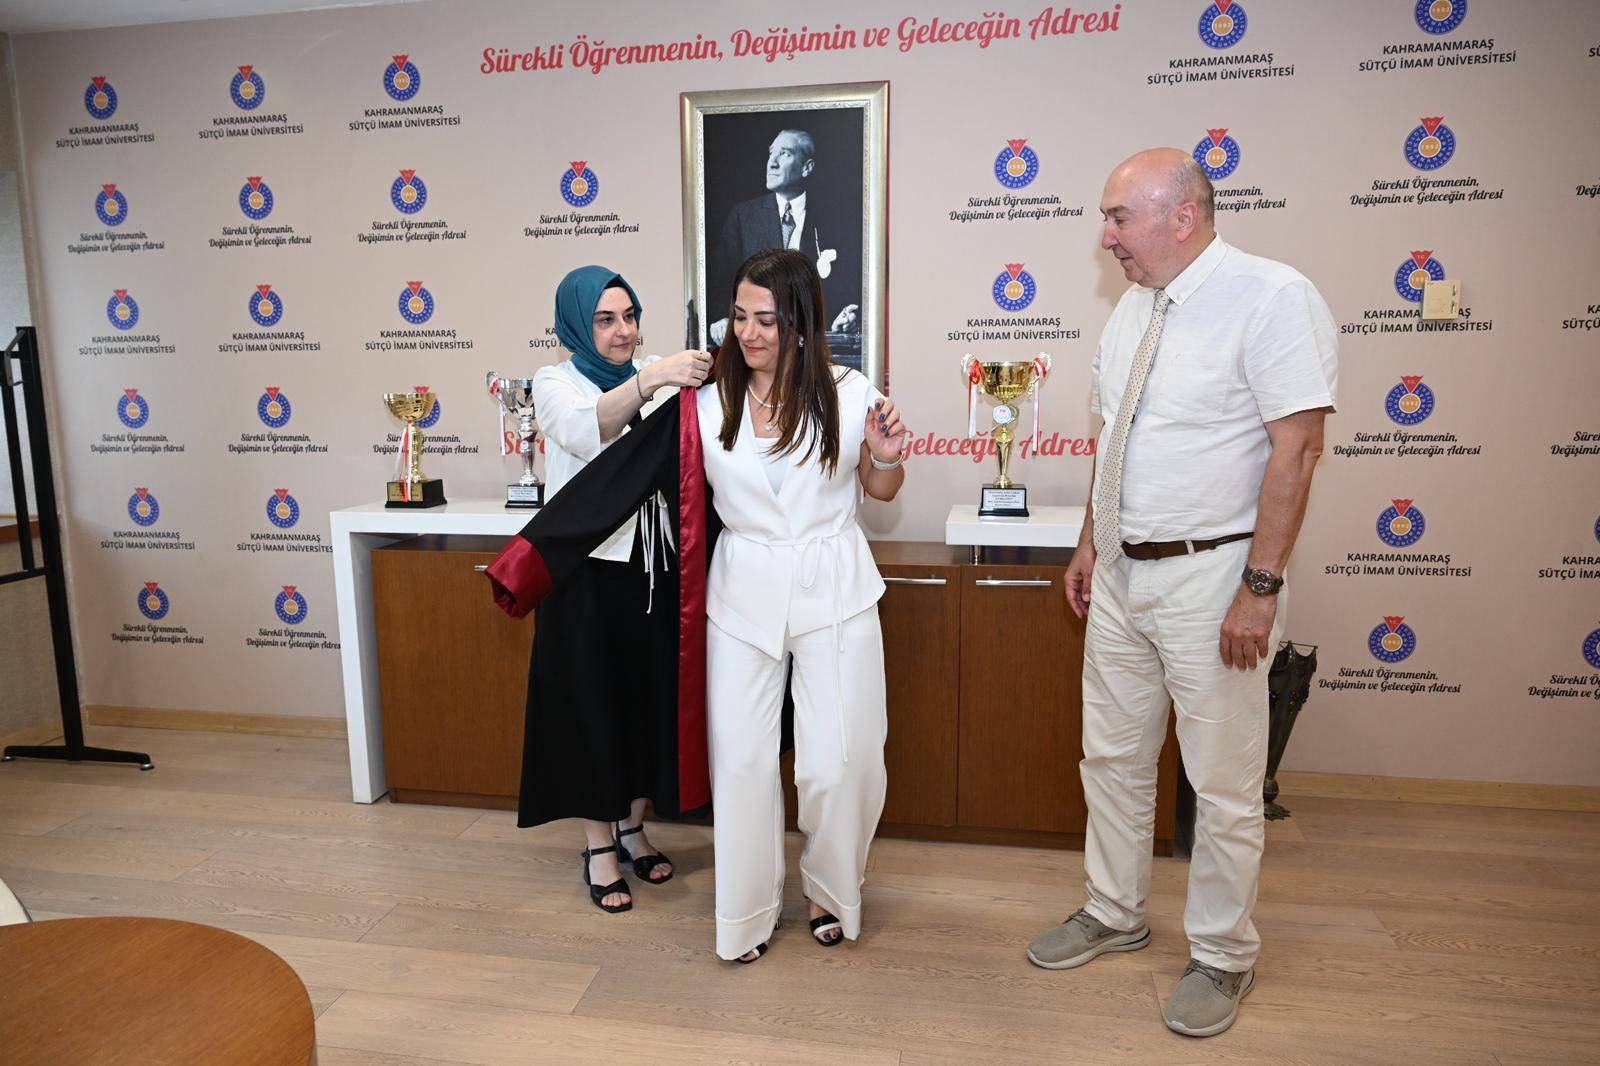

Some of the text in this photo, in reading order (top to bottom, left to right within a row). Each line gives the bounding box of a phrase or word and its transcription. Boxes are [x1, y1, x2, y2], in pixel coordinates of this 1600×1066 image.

[480, 3, 1122, 75] Sürekli Öğrenmenin, Değişimin ve Geleceğin Adresi
[1383, 38, 1494, 55] KAHRAMANMARAŞ
[1170, 53, 1273, 68] KAHRAMANMARAŞ
[1359, 50, 1516, 72] SÜTÇÜ İMAM ÜNİVERSİTESİ
[1148, 64, 1294, 86] SÜTÇÜ İMAM ÜNİVERSİTESİ
[364, 105, 444, 117] KAHRAMANMARAŞ
[213, 114, 288, 126] KAHRAMANMARAŞ
[349, 115, 460, 132] SÜTÇÜ İMAM ÜNİVERSİTESİ
[198, 124, 304, 140] SÜTÇÜ İMAM ÜNİVERSİTESİ
[1372, 176, 1479, 191] Sürekli Öğrenmenin,
[1213, 186, 1263, 197] renmenin,
[968, 194, 1062, 208] Sürekli Öğrenmenin,
[1252, 198, 1287, 210] Adresi
[1350, 189, 1504, 208] Değişimin ve Geleceğin Adresi
[539, 212, 620, 226] Sürekli Öğrenmenin,
[949, 210, 994, 223] Değişimin
[1008, 208, 1050, 221] Geleceğin
[1052, 206, 1084, 218] Adresi
[222, 224, 294, 238] Sürekli Öğrenmenin,
[372, 219, 448, 232] Sürekli Öğrenmenin,
[524, 227, 563, 239] Değişimin
[574, 225, 611, 236] Geleceğin
[612, 224, 639, 234] Adresi
[208, 238, 244, 249] Değişimin
[253, 235, 286, 247] Geleceğin
[288, 235, 312, 245] Adresi
[358, 233, 394, 245] Değişimin
[405, 231, 440, 243] Geleceğin
[441, 230, 466, 240] Adresi
[1364, 309, 1471, 319] KAHRAMAAŞ
[967, 317, 1061, 328] KAHRAMANMARAŞ
[1341, 318, 1492, 335] SÜTÇÜ İMAM ÜNİVERSİTESİ
[232, 331, 304, 341] KAHRAMANMARAŞ
[380, 330, 456, 339] KAHRAMANMARAŞ
[948, 328, 1080, 342] SÜTÇÜ İMAM ÜNİVERSİTESİ
[218, 342, 320, 354] SÜTÇÜ İMAM ÜNİVERSİTESİ
[365, 340, 473, 352] SÜTÇÜ İMAM ÜNİVERSİTESİ
[529, 340, 557, 349] SÜTÇÜ
[240, 432, 311, 444] Sürekli Öğrenmenin,
[1354, 432, 1458, 444] Sürekli Öğrenmenin,
[228, 444, 262, 454] Değişimin
[271, 443, 304, 454] Geleceğin
[305, 444, 328, 453] Adresi
[422, 443, 479, 455] eleceğin Adresi
[901, 431, 1097, 464] Geleceği Adres
[1333, 445, 1382, 458] Değişimin
[1398, 445, 1444, 458] Geleceğin
[1447, 444, 1482, 456] Adresi
[113, 531, 180, 540] KAHRAMANMARAŞ
[250, 533, 320, 543] KAHRAMANMARAŞ
[100, 541, 195, 552] SÜTÇÜ İMAM ÜNİVERSİTESİ
[236, 542, 333, 553] SÜTÇÜ İMAM ÜNİVERSİTES
[1347, 553, 1450, 565] KAHRAMANMARAŞ
[1325, 564, 1472, 576] SÜTÇÜ İMAM ÜNİVERSİTESİ
[1538, 568, 1600, 580] SÜTÇÜ İMA
[258, 628, 326, 640] Sürekli Öğrenmenin,
[246, 637, 279, 648] Değişimin
[288, 639, 320, 650] Geleceğin
[321, 640, 341, 649] Adres
[1338, 667, 1438, 683] Sürekli Öğrenmenin,
[1549, 674, 1588, 685] Sürekli
[1318, 679, 1366, 691] Değişimin
[1380, 679, 1426, 694] Geleceğin
[1428, 682, 1462, 693] Adresi
[1528, 686, 1578, 699] Değişimin
[1580, 689, 1592, 698] ve
